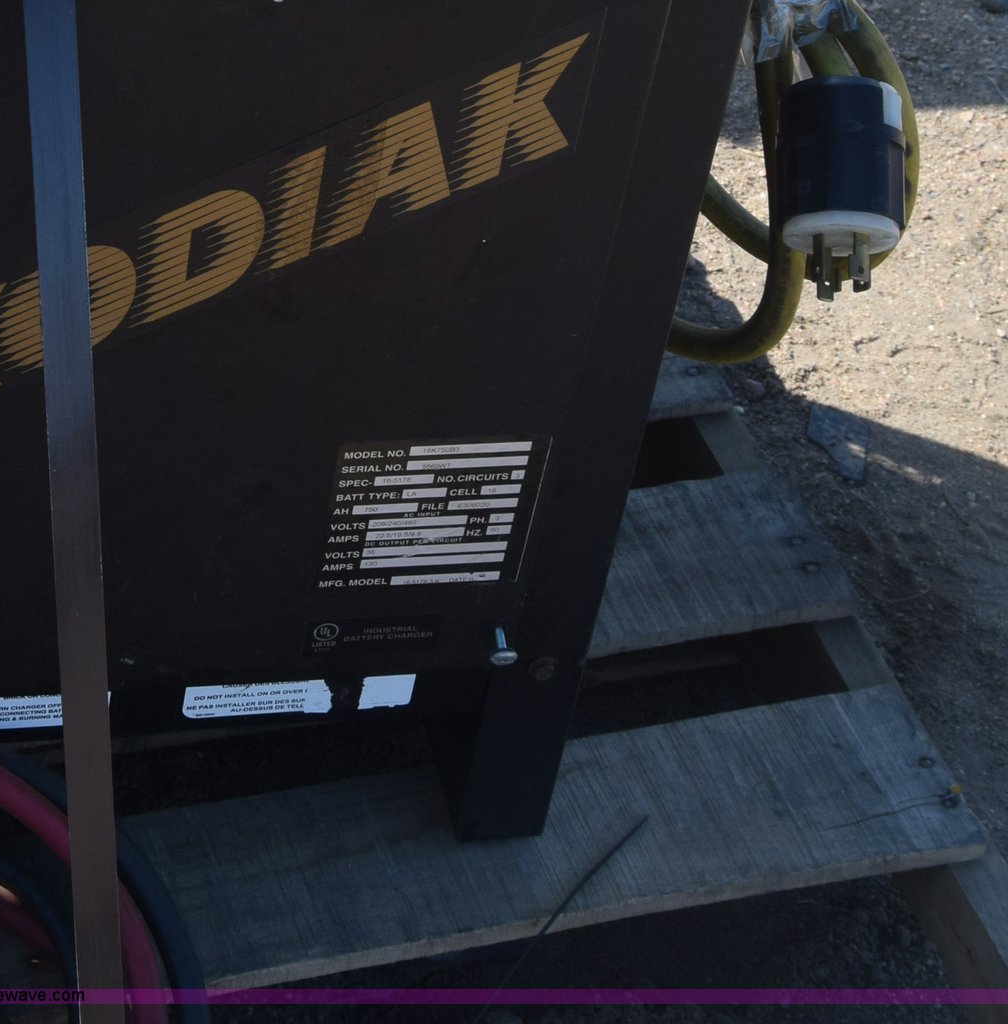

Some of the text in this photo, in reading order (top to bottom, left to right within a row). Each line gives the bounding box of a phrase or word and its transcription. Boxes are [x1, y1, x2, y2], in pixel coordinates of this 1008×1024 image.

[344, 449, 407, 460] MODEL NO.
[341, 464, 404, 474] SERIAL NO.
[338, 479, 373, 488] SPEC-
[335, 488, 478, 502] BATT TYPE: CELL
[333, 502, 446, 516] AH FILE
[330, 516, 488, 531] VOLTS PH.
[327, 529, 483, 544] AMPS HZ.
[379, 539, 410, 547] OUTPUT
[324, 550, 360, 560] VOLTS
[321, 562, 354, 572] AMPS
[318, 577, 388, 589] MFG. MODEL
[343, 634, 385, 642] BATTERY
[215, 701, 257, 709] INSTALLER
